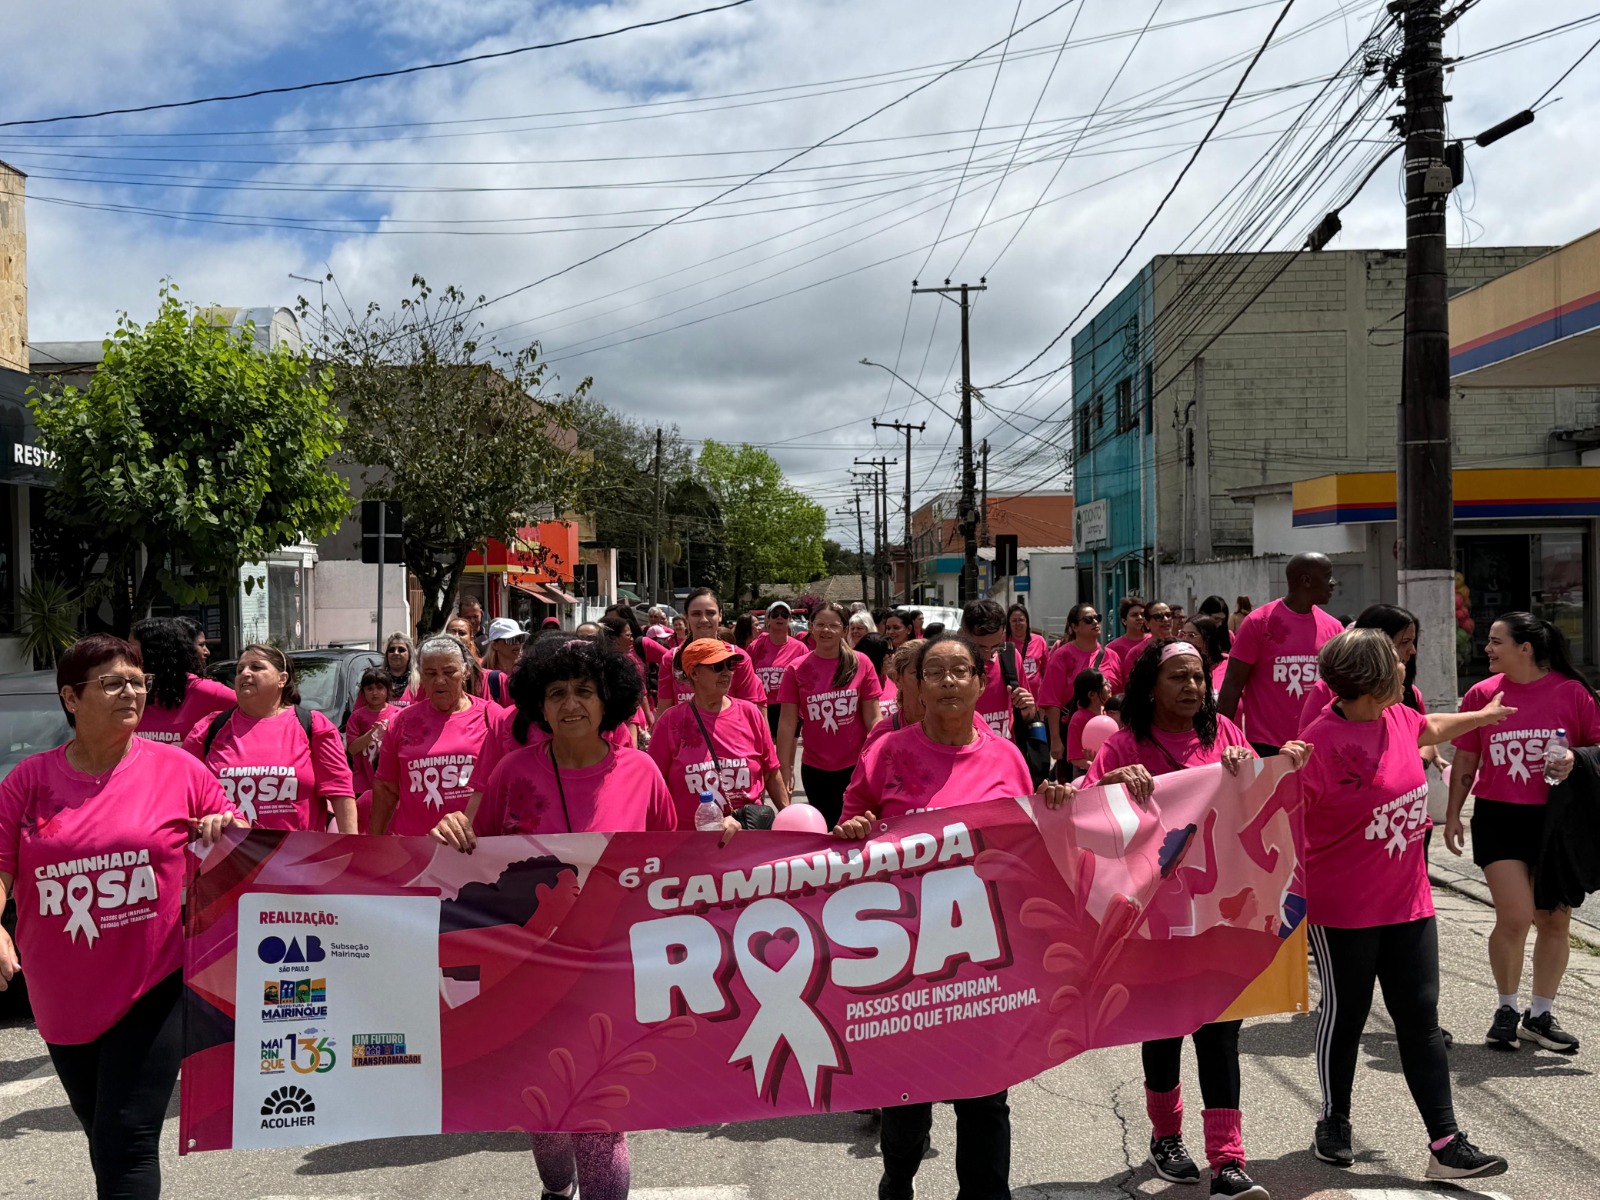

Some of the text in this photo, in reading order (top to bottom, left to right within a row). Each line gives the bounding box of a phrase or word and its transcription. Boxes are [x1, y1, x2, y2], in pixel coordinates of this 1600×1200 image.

[14, 443, 61, 470] RESTA
[1275, 655, 1319, 664] CAMINHAD
[806, 688, 858, 704] CAMINHADA
[806, 696, 859, 736] ROSA
[407, 755, 473, 771] CAMINHADA
[219, 765, 296, 778] CAMINHADA
[408, 764, 475, 813] ROSA
[1372, 781, 1429, 819] CAMINHAD
[34, 848, 150, 880] CAMINHADA
[647, 821, 975, 911] CAMINHADA
[35, 864, 159, 950] ROSA
[259, 911, 339, 926] REALIZAÇÃO:
[257, 935, 326, 964] OAB
[330, 942, 369, 952] Subseção
[331, 951, 371, 959] Mairinque
[279, 965, 290, 973] SÃO
[629, 865, 1001, 1108] ROSA
[846, 974, 1002, 1020] PASSOS QUE INSPIRAM.
[261, 1006, 328, 1019] MAIRINQUE
[845, 987, 1041, 1043] CUIDADO QUE TRANSFORMA.
[261, 1038, 283, 1050] MAI
[354, 1034, 404, 1045] UM FUTURO
[261, 1049, 280, 1060] RIN
[285, 1033, 337, 1075] 136
[260, 1059, 286, 1071] QUE
[260, 1115, 315, 1129] ACOLHER
